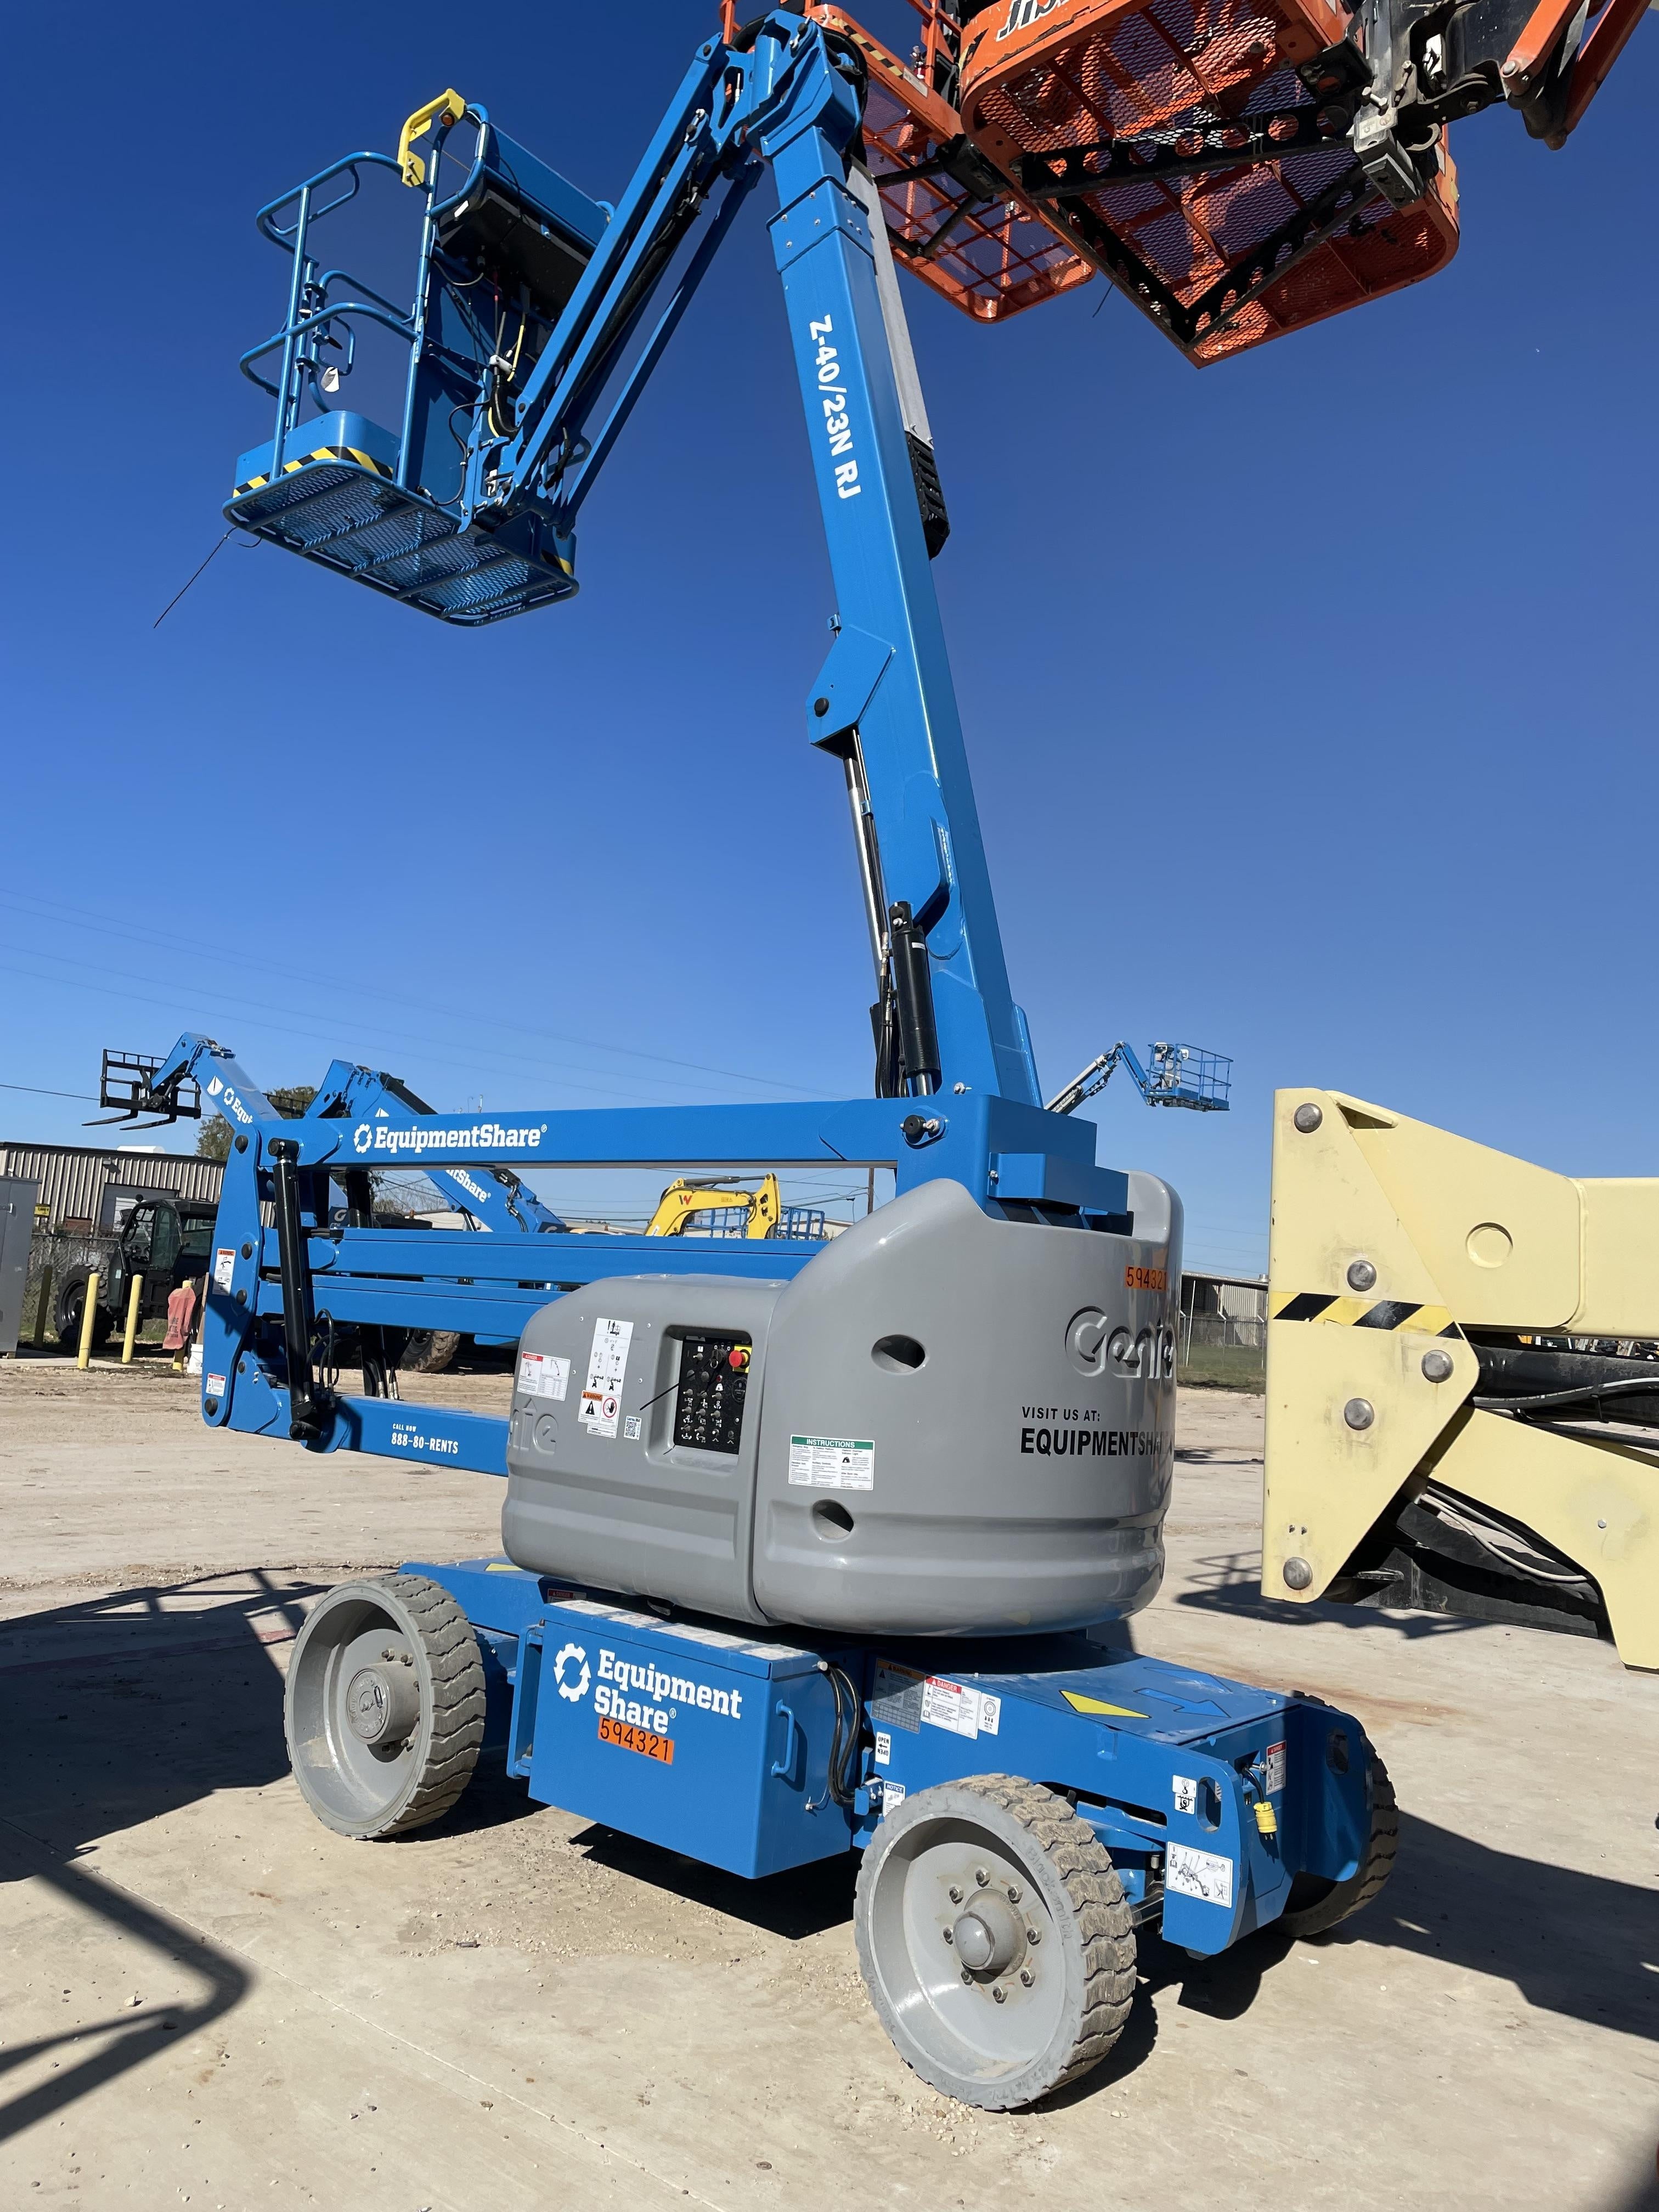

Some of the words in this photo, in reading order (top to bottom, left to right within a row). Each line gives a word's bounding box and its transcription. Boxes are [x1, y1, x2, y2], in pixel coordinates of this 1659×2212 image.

[809, 314, 853, 456] Z-40/23N
[834, 460, 861, 499] RJ
[1126, 1266, 1167, 1290] 594321
[1022, 1406, 1058, 1419] VISIT
[1063, 1409, 1079, 1420] US
[1084, 1410, 1100, 1421] AT:
[391, 1432, 459, 1454] 888-80-RENTS
[806, 1438, 855, 1448] INSTRUCTIONS
[597, 1649, 742, 1719] Equipment
[937, 1680, 958, 1692] DANGER
[600, 1718, 669, 1761] 594321
[886, 1784, 903, 1792] NOTICE
